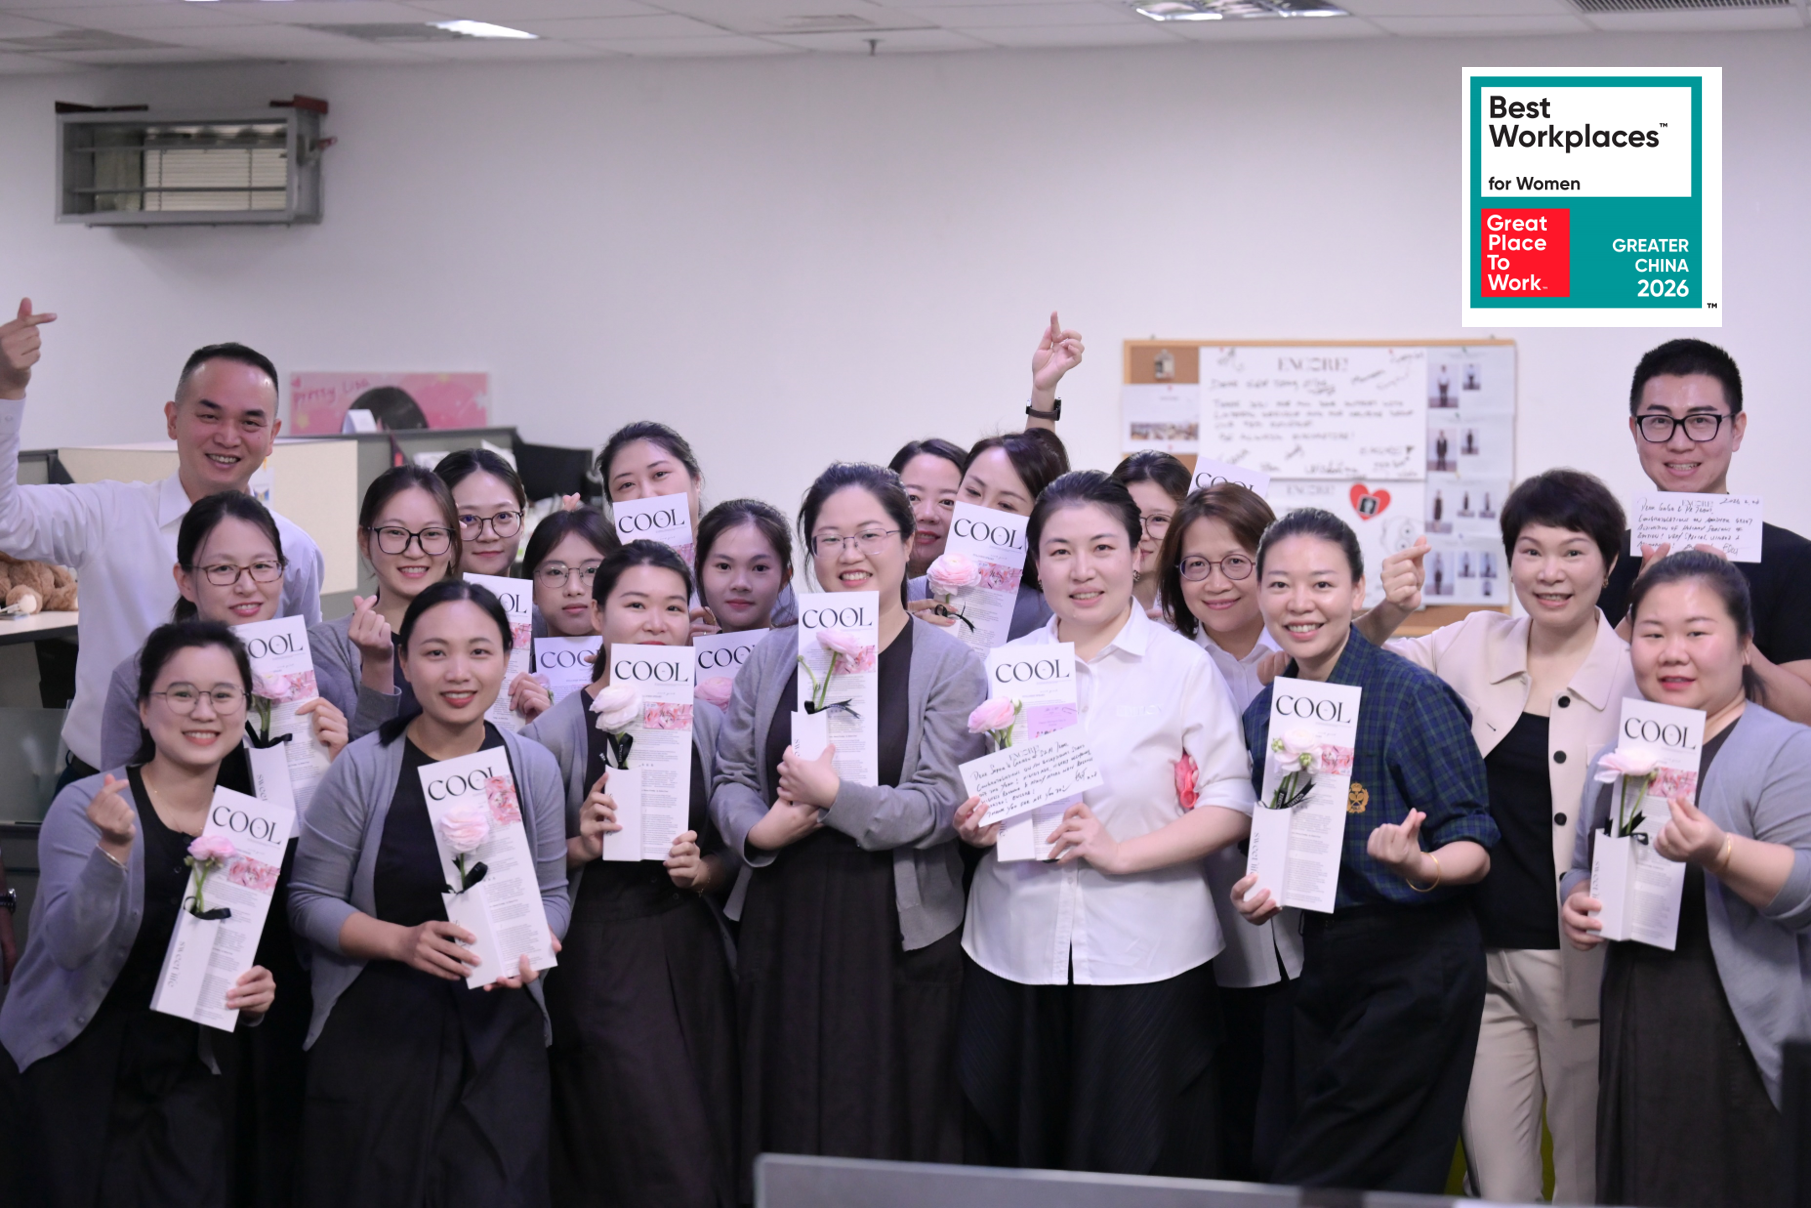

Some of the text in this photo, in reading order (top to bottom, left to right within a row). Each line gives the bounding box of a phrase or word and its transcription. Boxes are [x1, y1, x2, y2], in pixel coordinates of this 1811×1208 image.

[618, 508, 685, 534] COOL
[954, 518, 1022, 550] COOL
[499, 593, 526, 614] OL
[802, 607, 872, 628] COOL
[248, 633, 303, 658] OOL
[698, 644, 756, 669] COO
[540, 650, 597, 668] COO
[614, 660, 688, 682] COOL
[996, 659, 1070, 683] COOL
[1276, 694, 1351, 724] COOL
[1624, 718, 1696, 750] COOL
[212, 806, 282, 845] COOL
